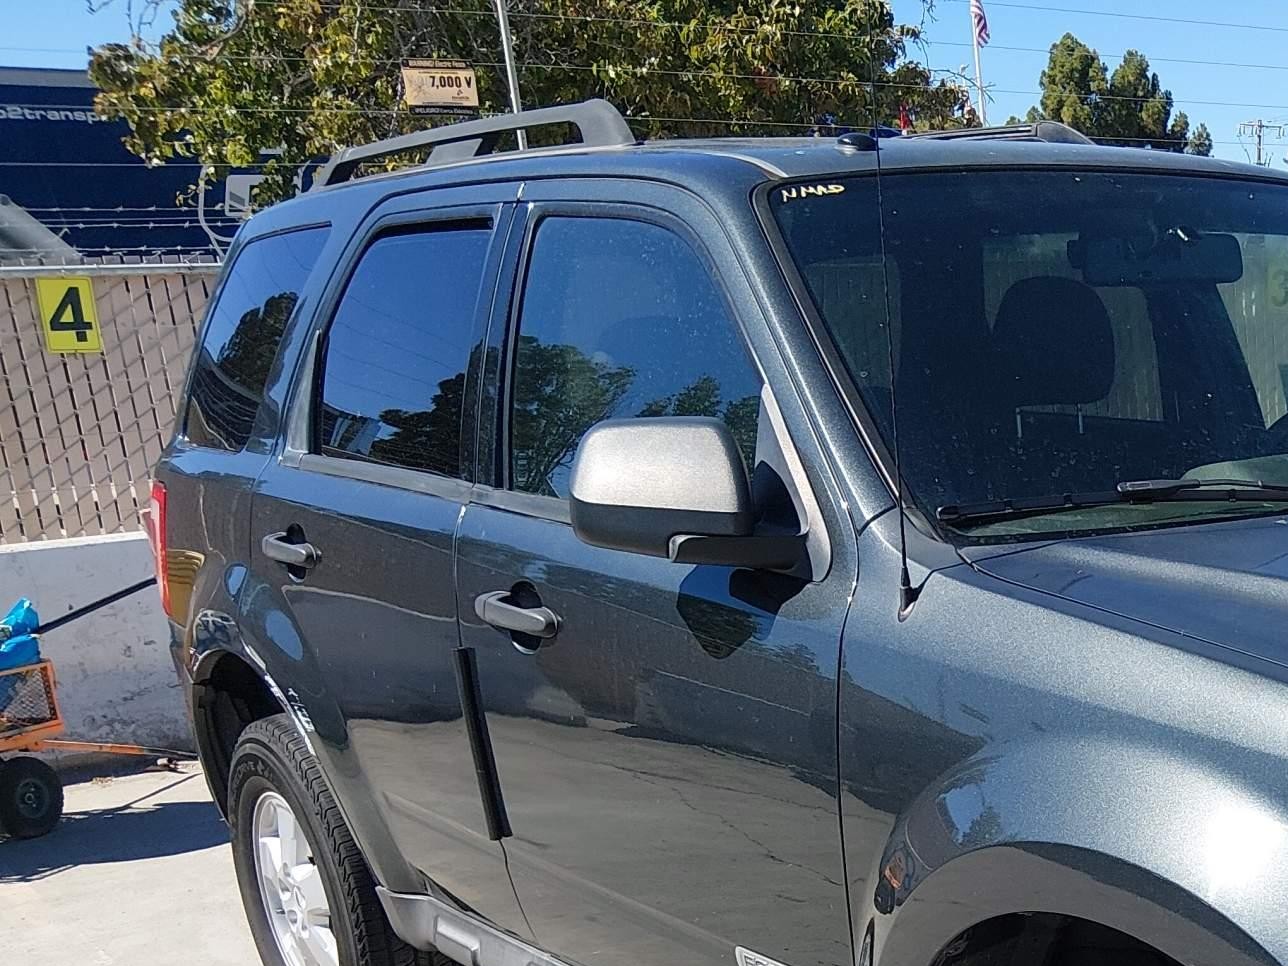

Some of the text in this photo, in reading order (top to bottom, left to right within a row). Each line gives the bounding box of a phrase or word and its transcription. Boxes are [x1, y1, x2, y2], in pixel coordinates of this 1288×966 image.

[429, 75, 472, 89] 7,000 V
[49, 286, 93, 342] 4
